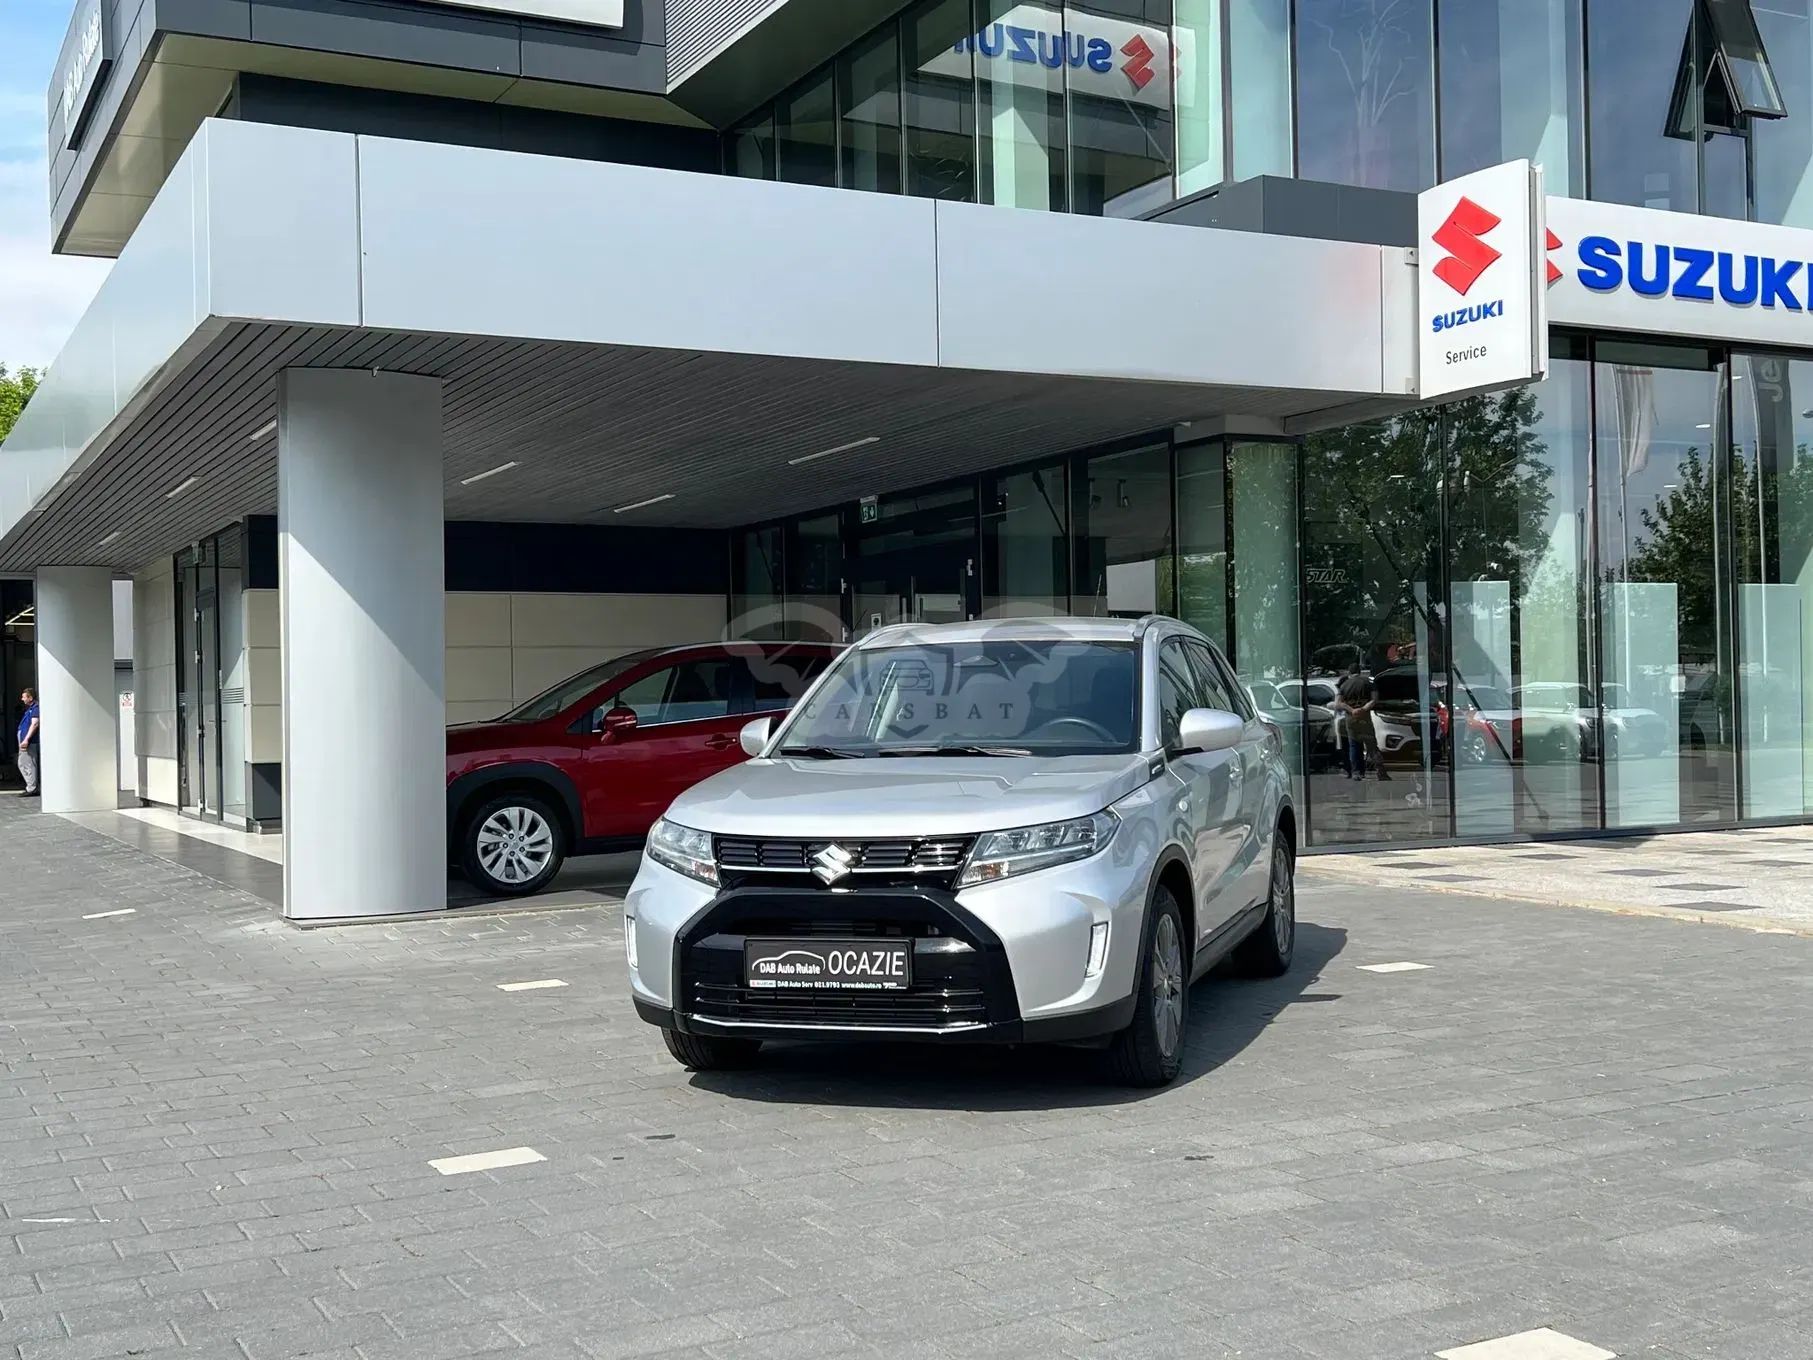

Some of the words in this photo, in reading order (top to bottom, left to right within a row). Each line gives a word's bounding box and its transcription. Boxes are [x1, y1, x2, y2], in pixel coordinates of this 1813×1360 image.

[1432, 300, 1504, 332] SUZUKI
[1446, 345, 1487, 365] Service
[760, 962, 776, 974] DAB
[777, 962, 795, 974] Auto
[796, 963, 821, 975] Rulate
[828, 950, 905, 976] OCAZIE
